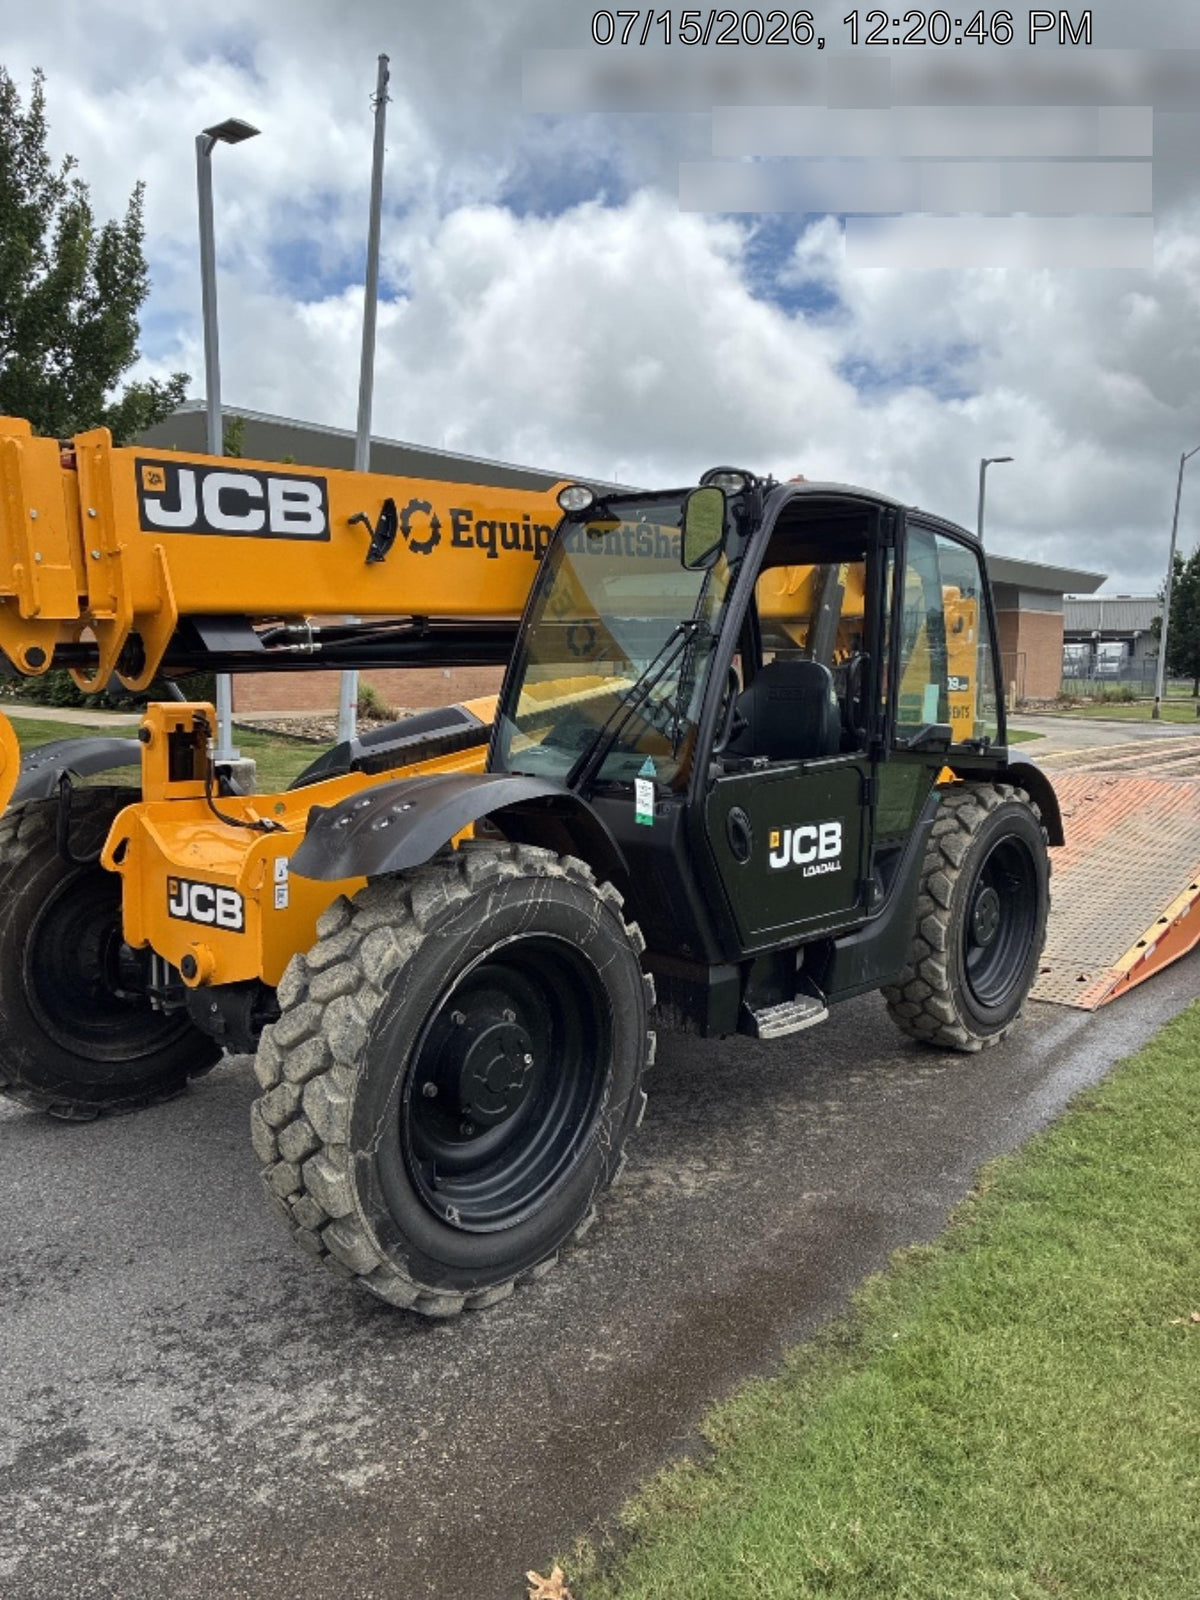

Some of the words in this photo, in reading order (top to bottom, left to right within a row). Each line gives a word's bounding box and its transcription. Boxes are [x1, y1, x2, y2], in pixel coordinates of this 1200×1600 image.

[143, 468, 326, 535] JCB
[768, 822, 842, 869] JCB
[803, 860, 842, 877] LOADALL
[169, 881, 243, 929] JCB
